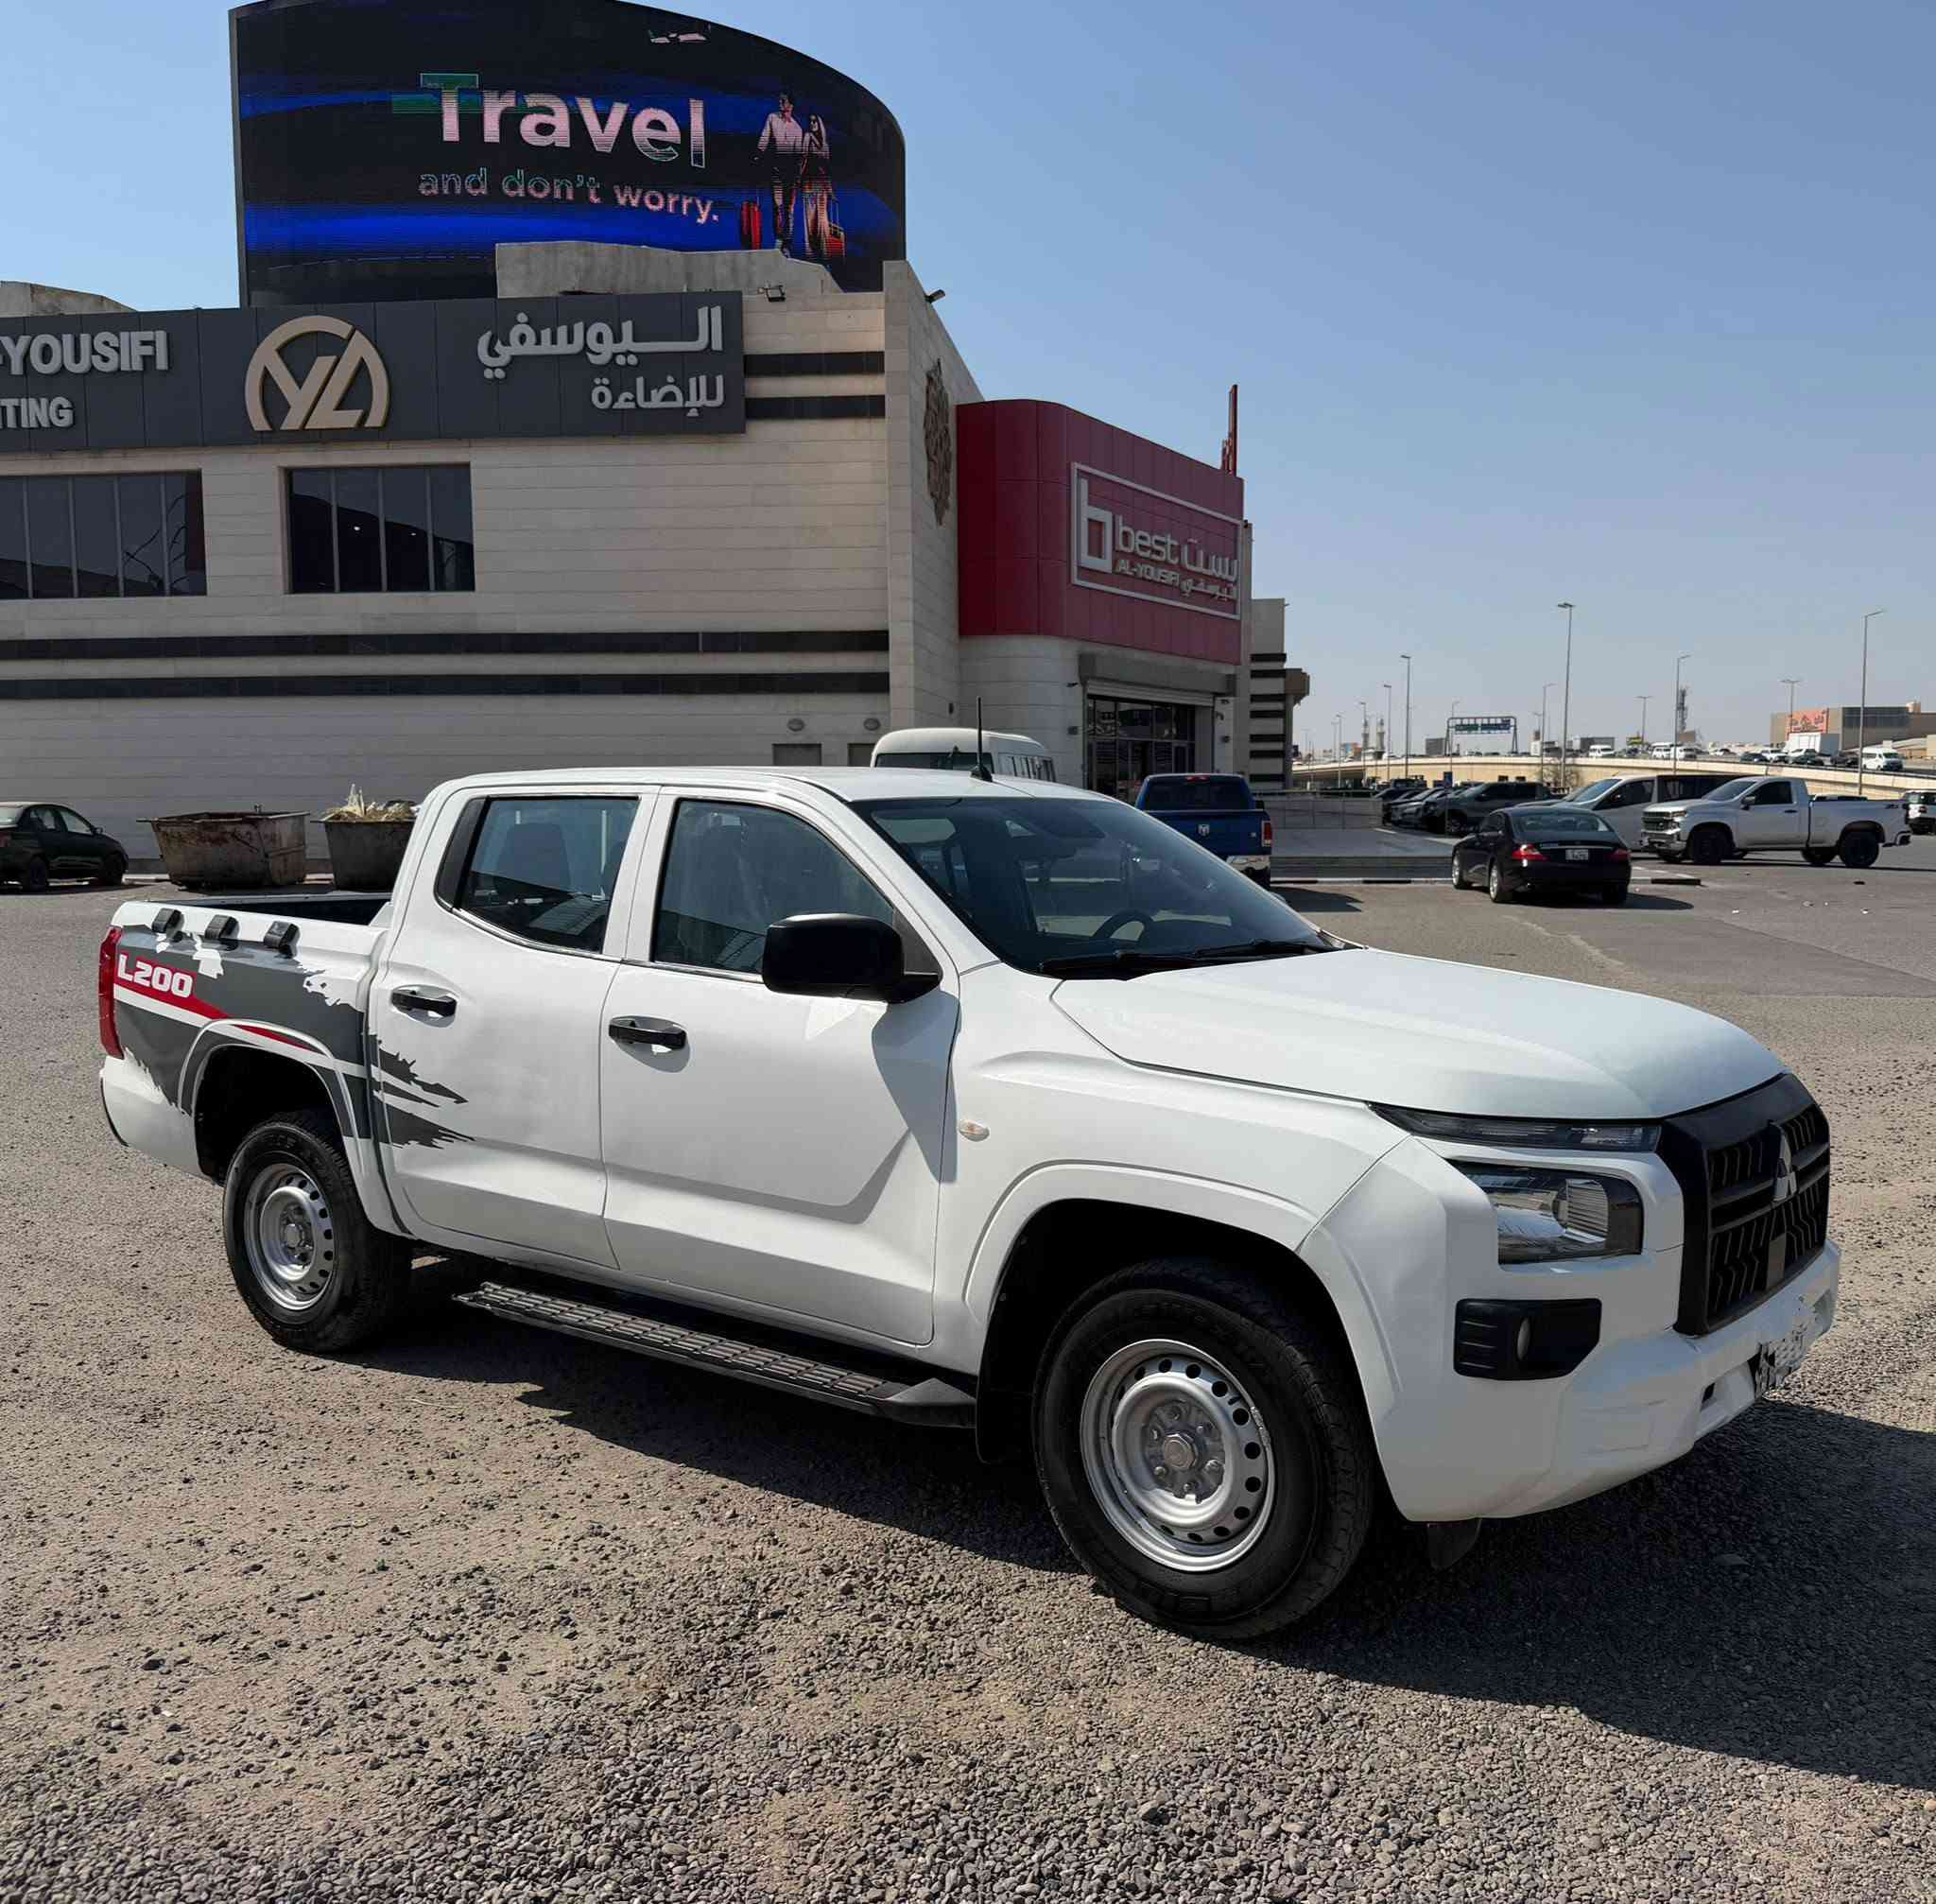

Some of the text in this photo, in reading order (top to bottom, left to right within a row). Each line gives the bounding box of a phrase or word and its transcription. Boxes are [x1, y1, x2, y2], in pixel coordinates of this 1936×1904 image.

[421, 73, 705, 168] Travel
[419, 167, 718, 224] and don't worry.
[0, 396, 74, 428] TING
[591, 374, 724, 417] للإضاءة
[1118, 514, 1179, 565] best
[116, 954, 194, 999] L200
